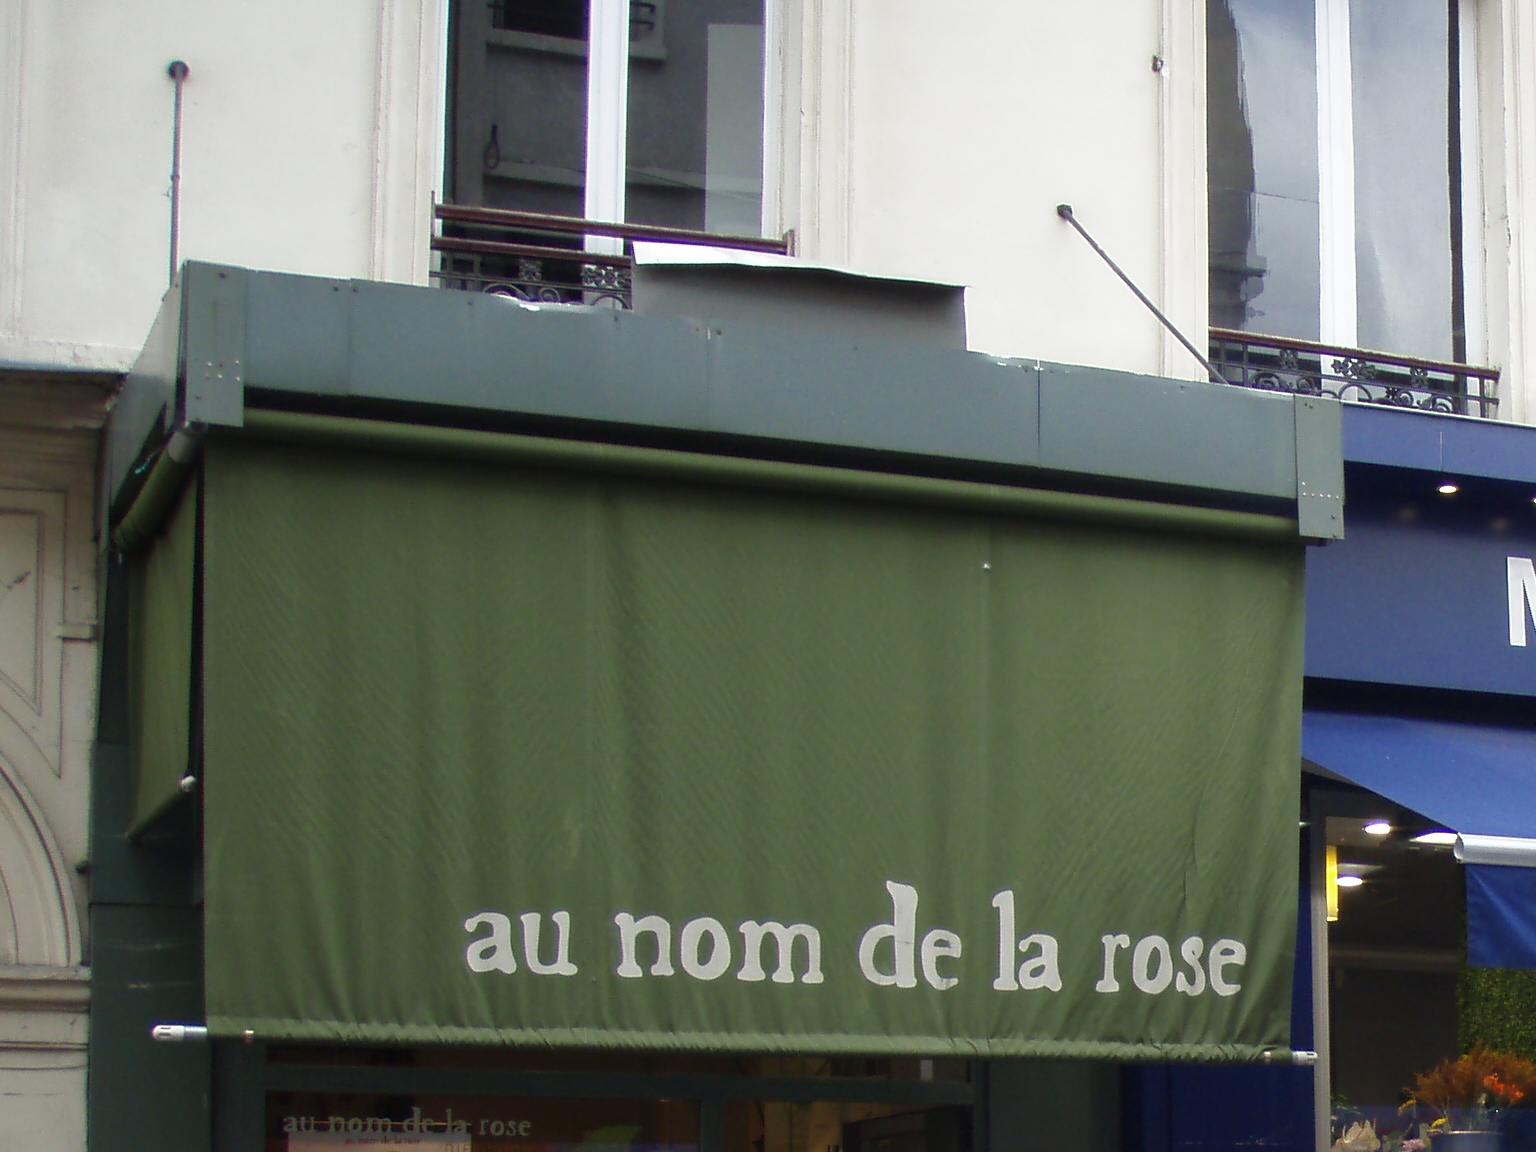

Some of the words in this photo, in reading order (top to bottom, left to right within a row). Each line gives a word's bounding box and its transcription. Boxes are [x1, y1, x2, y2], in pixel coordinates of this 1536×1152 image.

[464, 911, 578, 976] au
[613, 912, 825, 986] nom
[857, 879, 963, 990] de
[991, 889, 1063, 992] la
[1094, 931, 1248, 997] rose
[283, 1115, 316, 1133] au
[329, 1115, 393, 1134] nom
[402, 1106, 435, 1134] de
[446, 1108, 469, 1135] la
[478, 1118, 532, 1137] rose
